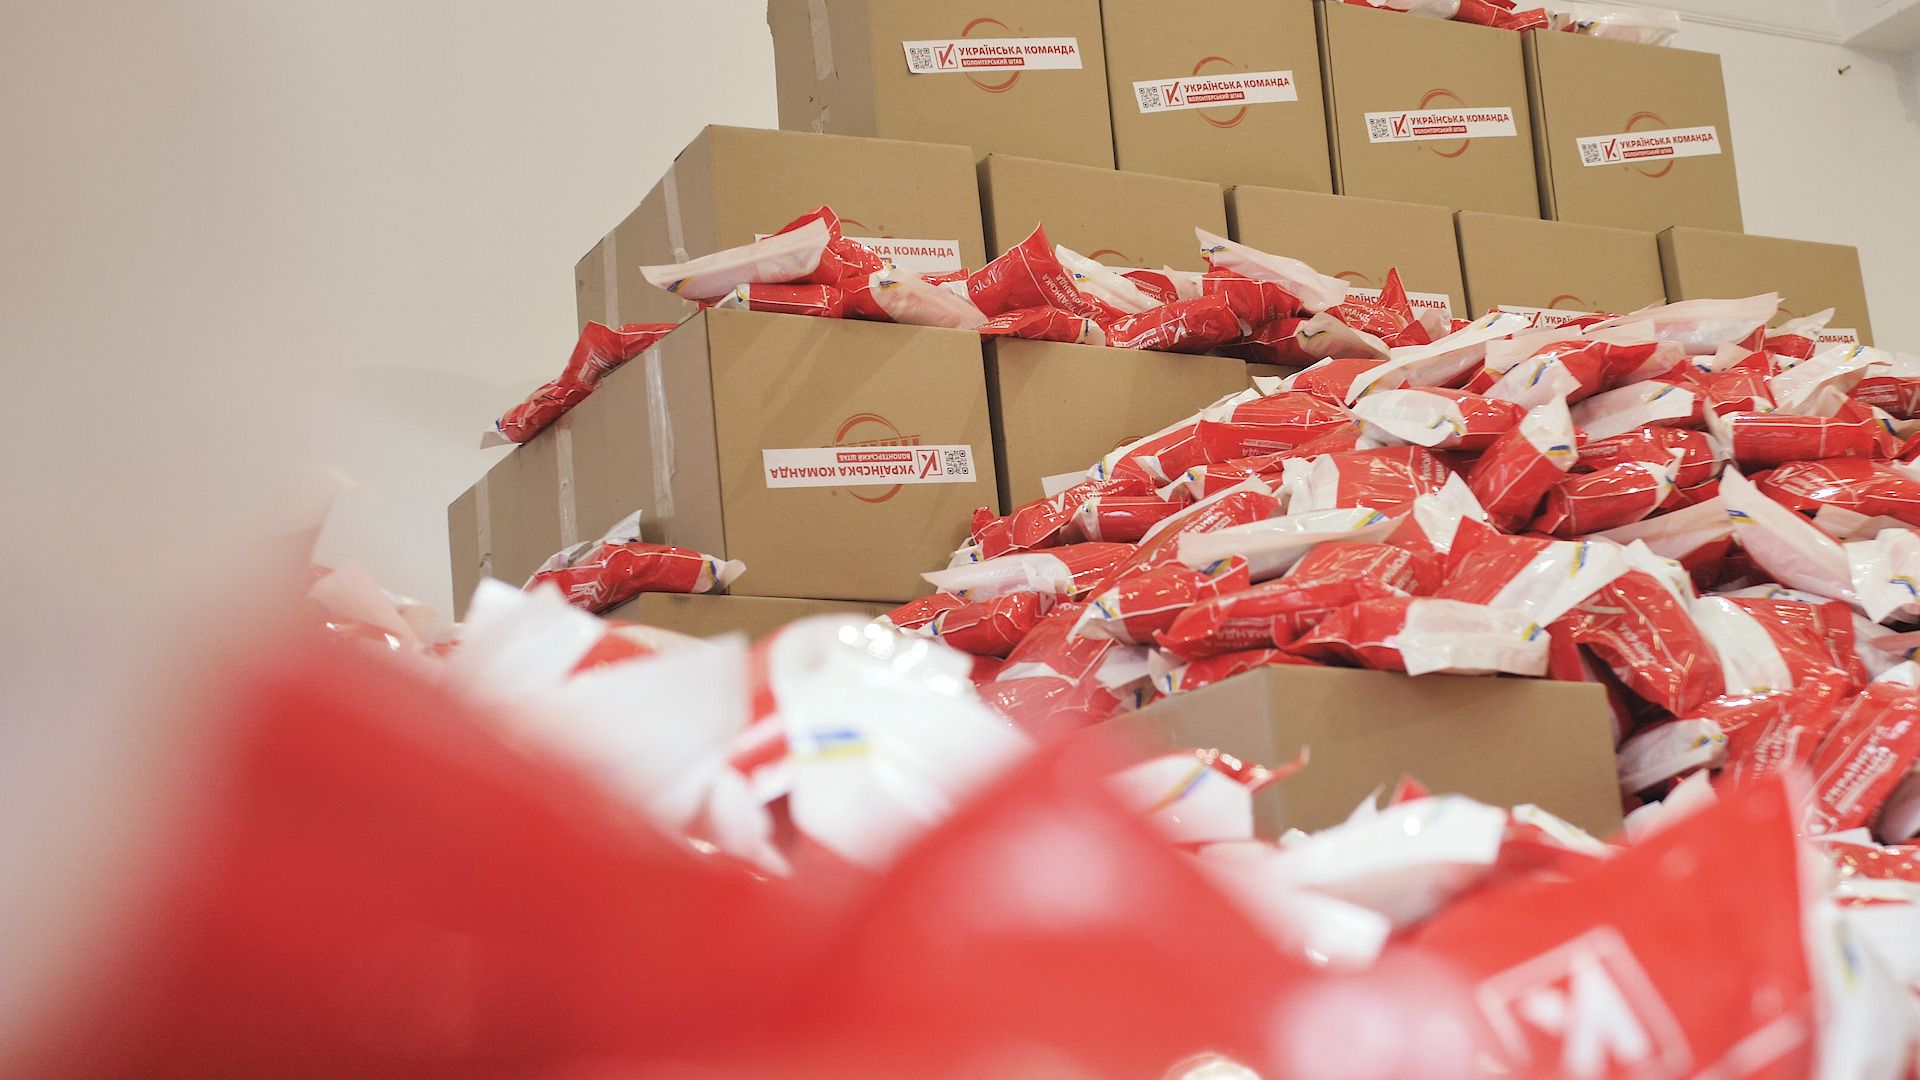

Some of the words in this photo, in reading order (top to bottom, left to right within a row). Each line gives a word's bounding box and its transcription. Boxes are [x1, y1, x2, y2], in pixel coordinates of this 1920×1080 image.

[958, 44, 1022, 56] УКРАЇНСЬКА
[1024, 45, 1076, 55] КОМАНДА
[1183, 80, 1242, 93] УКРАЇНСЬКА
[1243, 77, 1290, 88] КОМАНДА
[1188, 93, 1229, 103] ВОЛОНТЕРСЬКИЙ
[1410, 114, 1465, 125] УКРАЇНСЬКА
[1466, 113, 1510, 123] КОМАНДА
[1619, 136, 1671, 149] УКРАЇНСЬКА
[1672, 133, 1713, 144] КОМАНДА
[893, 246, 954, 258] КОМАНДА
[1408, 298, 1447, 310] МАНДА
[838, 453, 857, 462] ШТАБ
[857, 452, 911, 462] ВОЛОНТЕРСЬКИЙ
[769, 466, 836, 479] КОМАНДА
[838, 464, 915, 478] УКРАЇНСЬКА
